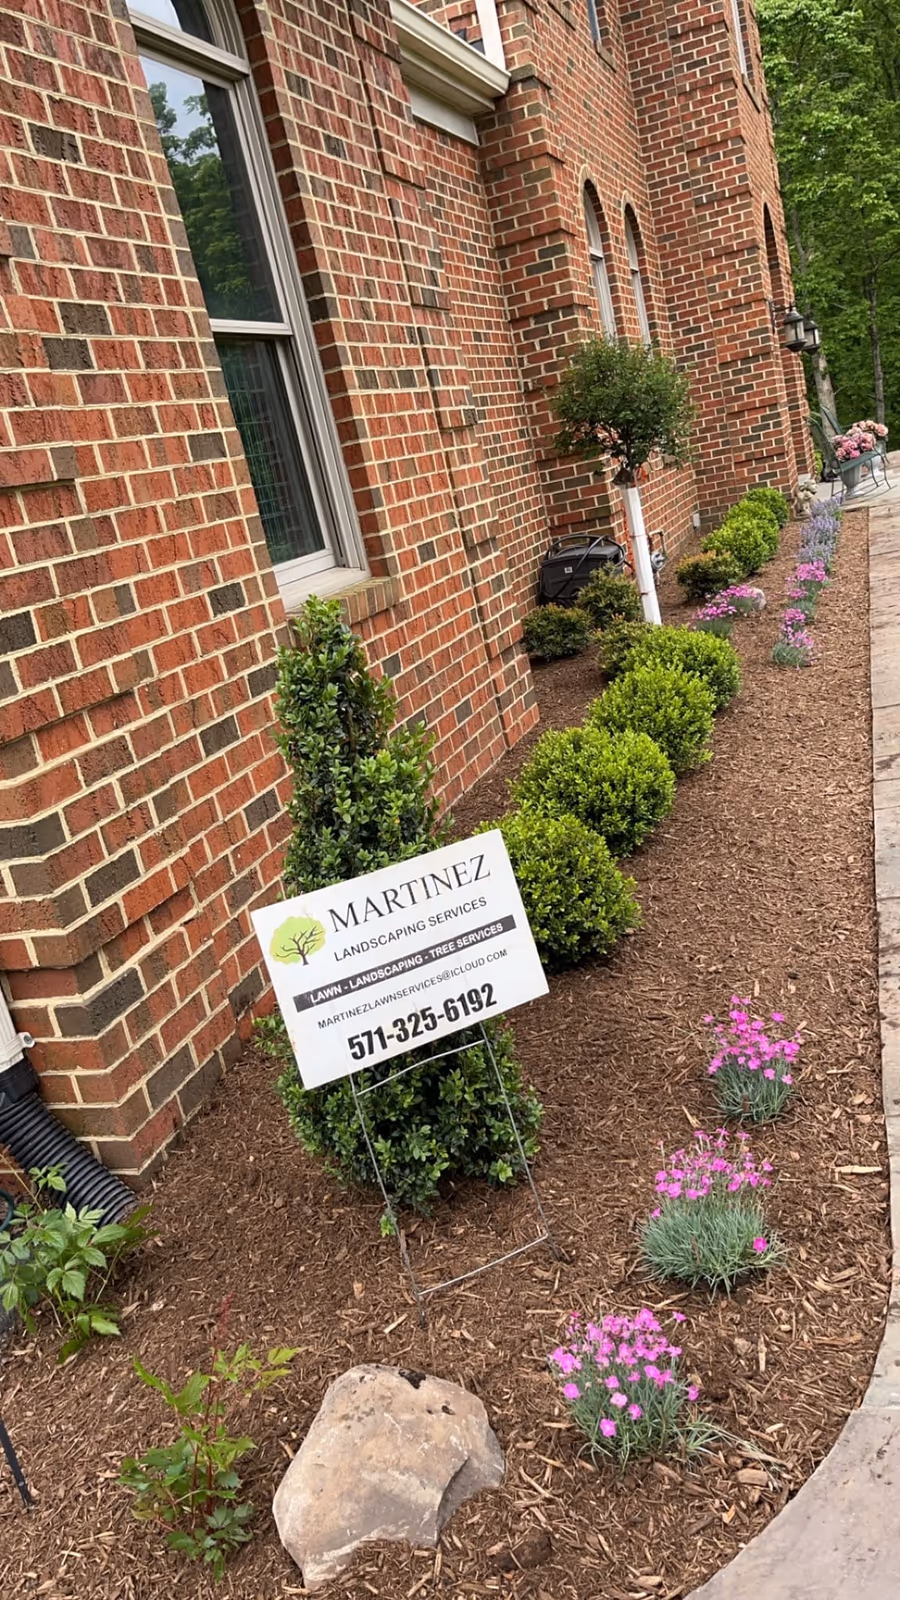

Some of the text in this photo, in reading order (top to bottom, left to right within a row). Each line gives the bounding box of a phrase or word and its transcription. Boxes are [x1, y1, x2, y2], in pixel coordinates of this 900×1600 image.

[328, 854, 491, 932] MARTINEZ
[334, 896, 488, 962] LANDSCAPING SERVICES
[310, 986, 342, 1004] LAWN
[349, 957, 424, 989] LANDSCAPING
[429, 942, 456, 960] TREE
[456, 923, 504, 948] SERVICES
[318, 949, 508, 1030] MARTINEZLAWNSERVICES@ICLOUDCOM
[348, 983, 498, 1060] 571-325-6192
